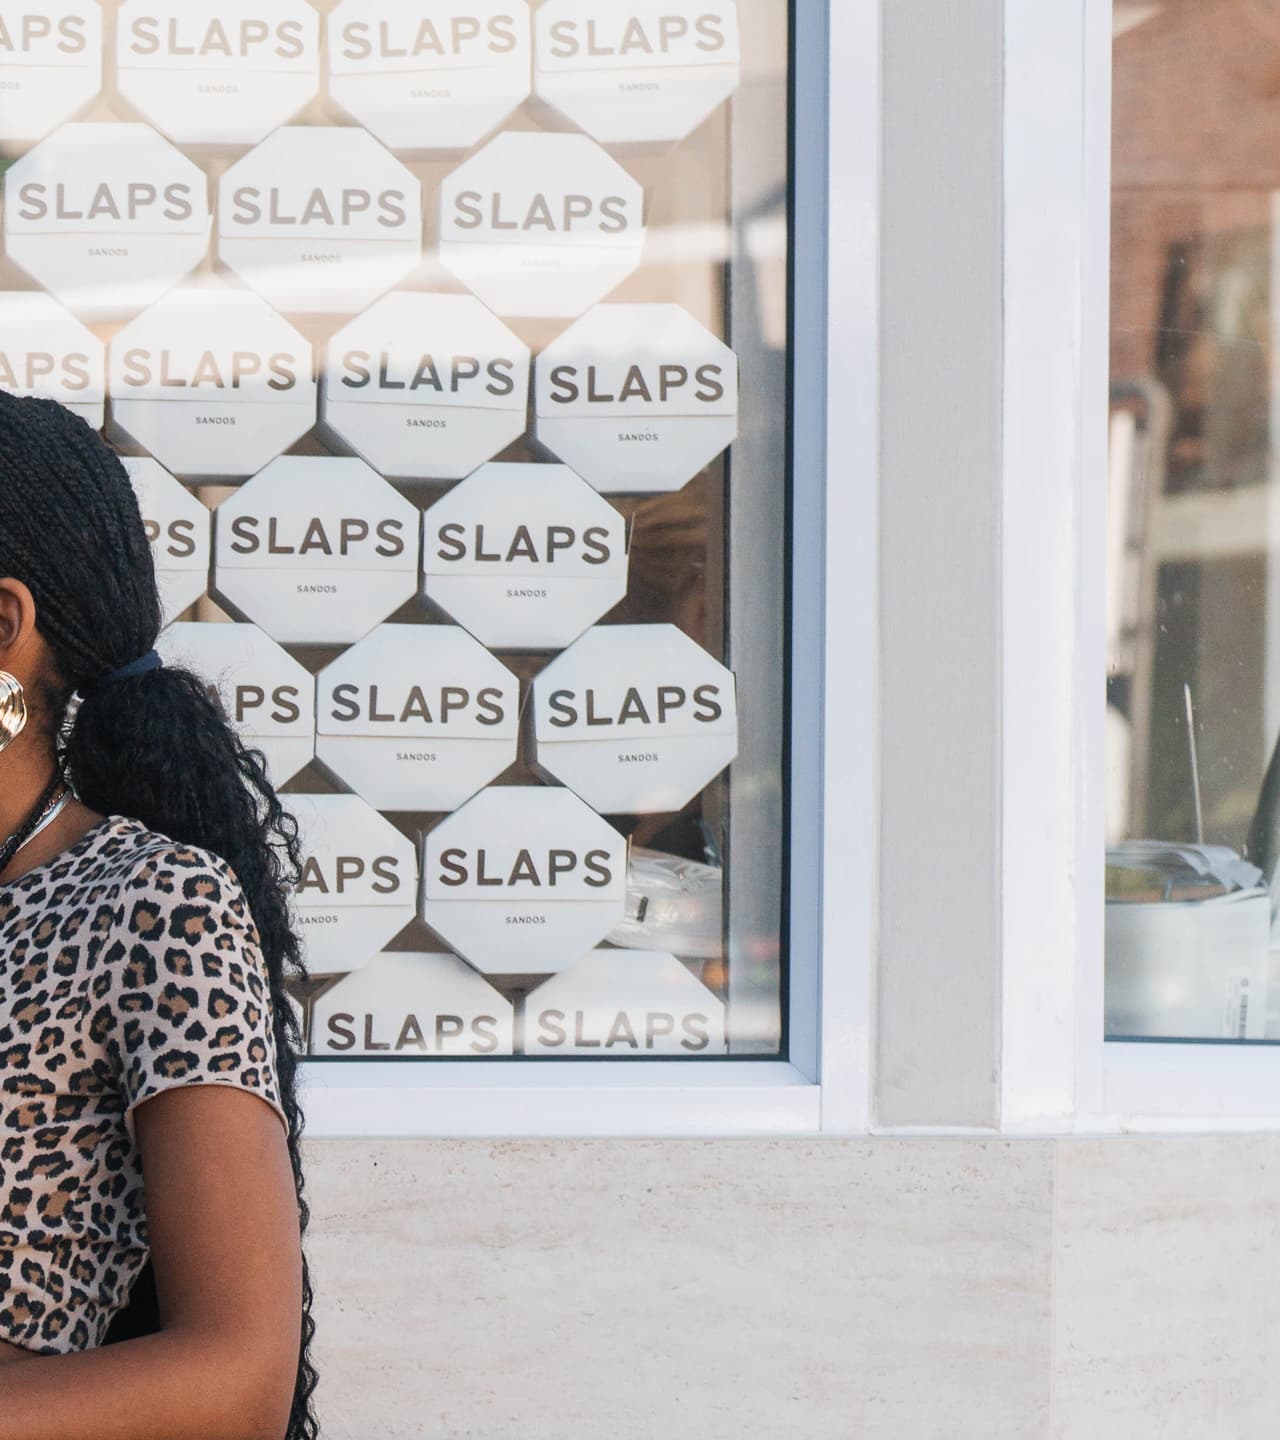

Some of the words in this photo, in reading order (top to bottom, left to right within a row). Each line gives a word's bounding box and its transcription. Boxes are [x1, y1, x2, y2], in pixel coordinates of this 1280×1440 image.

[131, 17, 304, 58] SLAPS
[342, 15, 516, 60] SLAPS
[550, 14, 724, 58] SLAPS
[19, 183, 192, 221] SLAPS
[233, 187, 405, 227] SLAPS
[454, 191, 627, 233] SLAPS
[88, 248, 128, 256] SANDOS
[123, 349, 295, 391] SLAPS
[341, 350, 515, 396] SLAPS
[550, 364, 723, 403] SLAPS
[406, 419, 446, 428] SANDOS
[618, 433, 658, 441] SANDOS
[231, 516, 404, 557] SLAPS
[438, 524, 610, 564] SLAPS
[297, 585, 337, 593] SANDOS
[331, 684, 504, 725] SLAPS
[549, 685, 722, 727] SLAPS
[396, 753, 436, 761] SANDOS
[618, 754, 658, 762] SANDOS
[295, 856, 401, 894] APS
[439, 849, 611, 887] SLAPS
[506, 916, 546, 924] SANDOS
[327, 1013, 496, 1050] SLAPS
[538, 1009, 709, 1051] SLAPS
